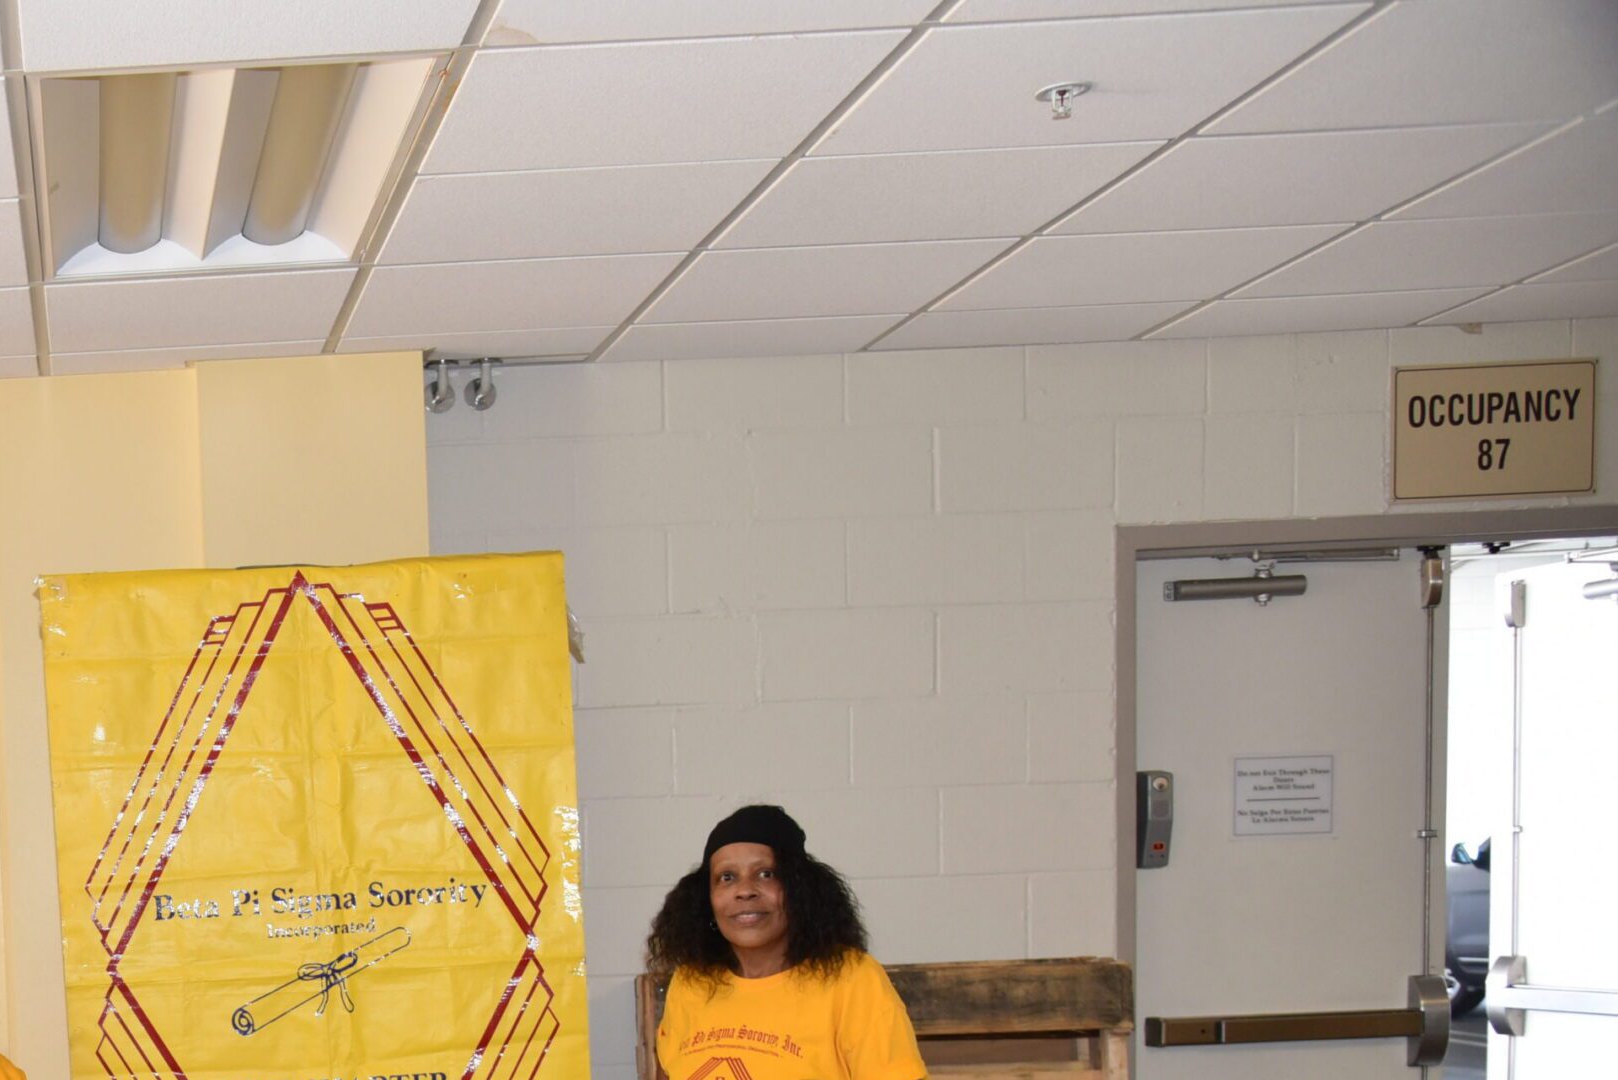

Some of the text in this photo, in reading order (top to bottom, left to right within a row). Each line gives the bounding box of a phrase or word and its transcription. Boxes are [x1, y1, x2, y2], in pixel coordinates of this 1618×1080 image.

[1408, 388, 1581, 428] OCCUPANCY
[1477, 438, 1511, 471] 87
[154, 878, 487, 921] Beta Pi Sigma Sorority
[266, 917, 376, 940] Incorporated
